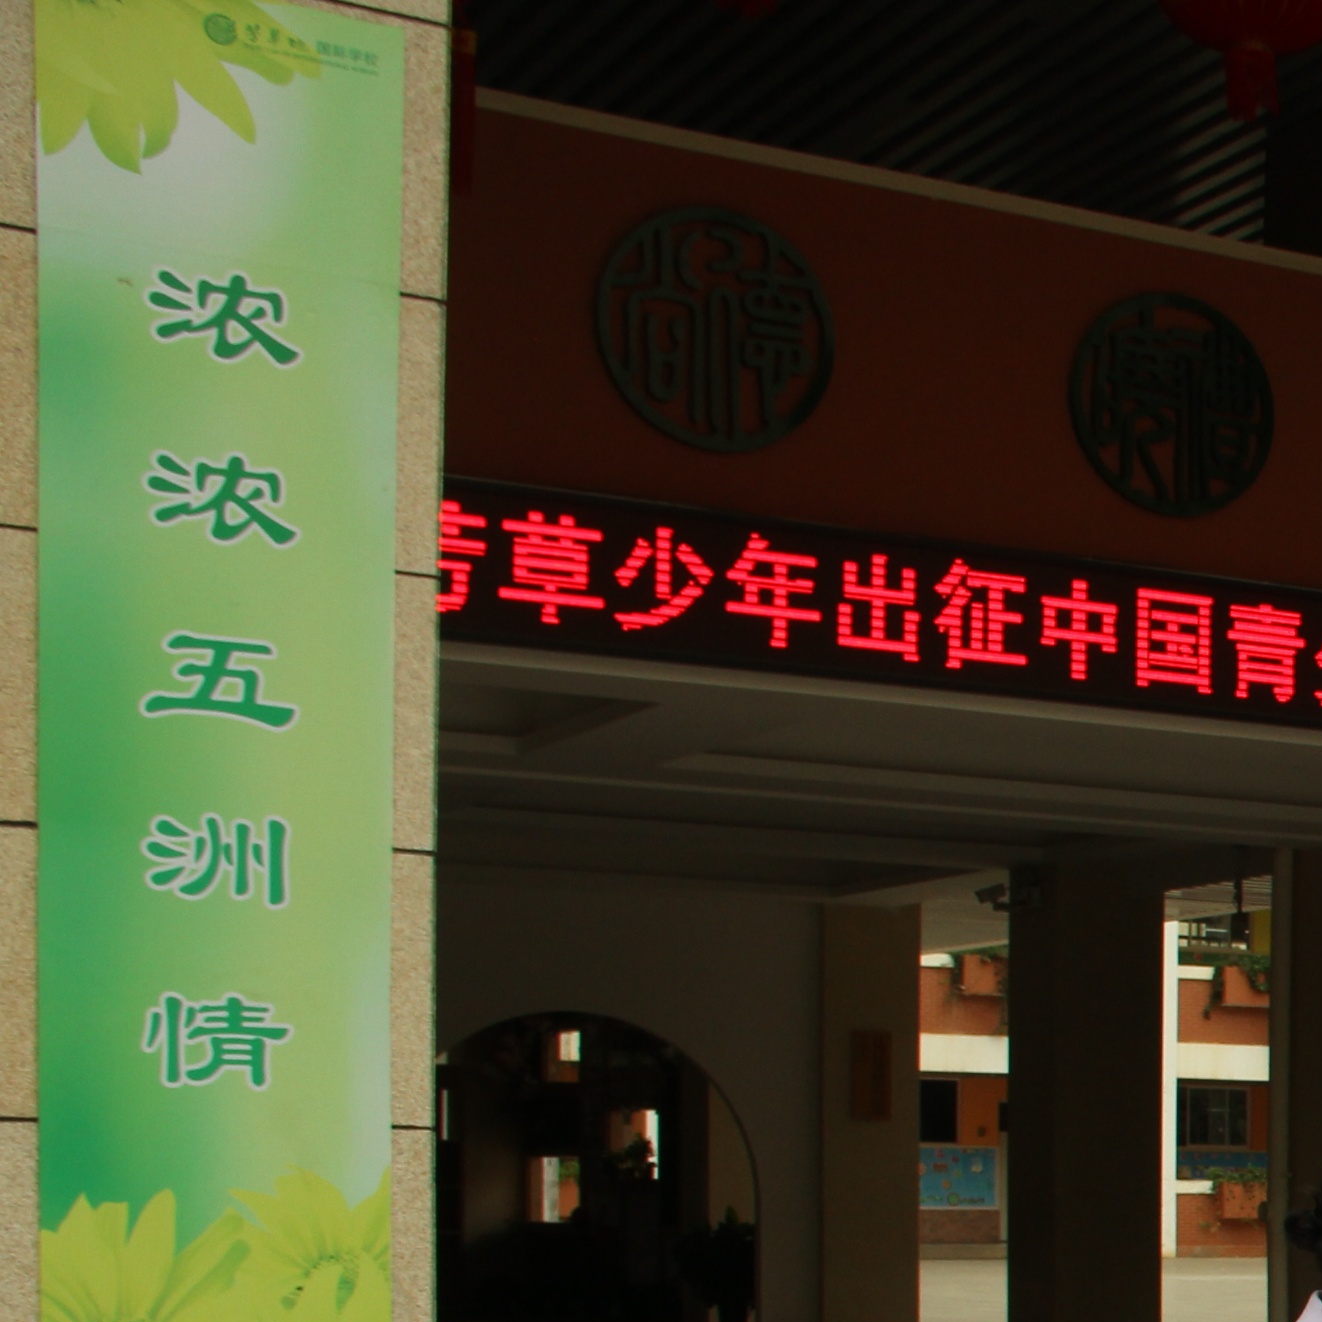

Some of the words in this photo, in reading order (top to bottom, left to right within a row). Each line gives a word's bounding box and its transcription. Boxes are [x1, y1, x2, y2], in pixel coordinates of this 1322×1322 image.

[143, 270, 300, 1088] 浓浓五洲情
